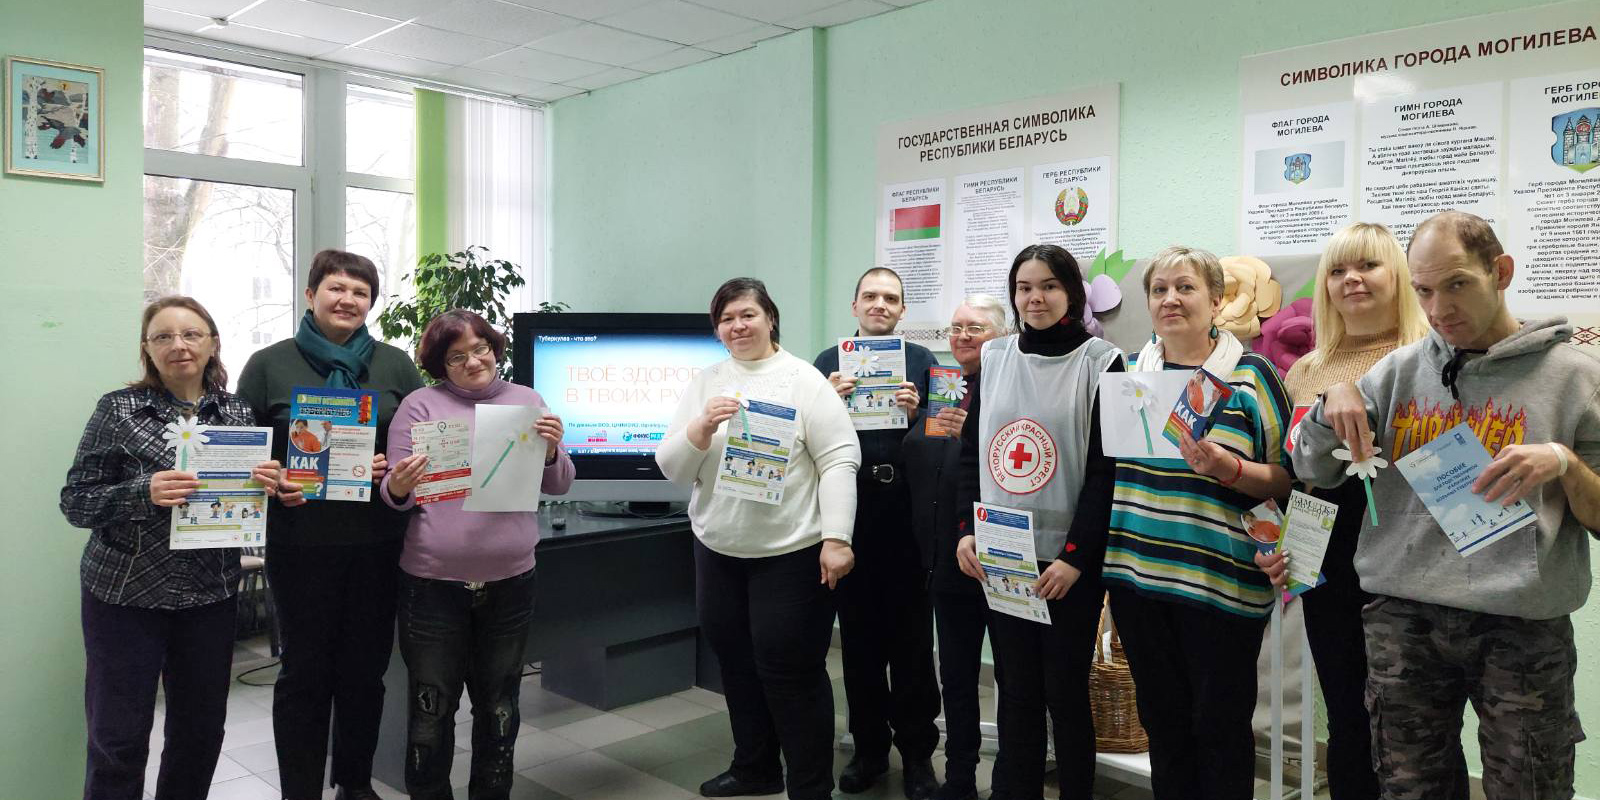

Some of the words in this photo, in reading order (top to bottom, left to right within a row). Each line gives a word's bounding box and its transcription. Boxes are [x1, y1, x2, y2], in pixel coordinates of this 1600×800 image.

[1281, 57, 1387, 87] СИМВОЛИКА
[1395, 44, 1471, 69] ГОРОДА
[1478, 26, 1597, 57] МОГИЛЕВА
[1545, 85, 1573, 94] ГЕРБ
[1394, 102, 1421, 113] ГИМН
[1423, 98, 1463, 110] ГОРОДА
[1271, 120, 1294, 128] ФЛАГ
[1297, 115, 1330, 126] ГОРОДА
[1401, 109, 1455, 121] МОГИЛЕВА
[899, 119, 1009, 149] ГОСУДАРСТВЕННАЯ
[1014, 105, 1095, 130] СИМВОЛИКА
[1277, 125, 1323, 137] МОГИЛЕВА
[920, 140, 995, 162] РЕСПУБЛИКИ
[999, 129, 1068, 151] БЕЛАРУСЬ
[1060, 166, 1101, 177] РЕСПУБЛИКИ
[980, 177, 1018, 187] РЕСПУБЛИКИ
[1055, 176, 1088, 184] БЕЛАРУСЬ
[976, 186, 1004, 194] БЕЛАРУСЬ
[567, 365, 616, 382] ТВОЁ
[566, 389, 579, 403] В
[588, 388, 651, 403] ТВОИХ
[1175, 401, 1197, 430] КАК
[291, 456, 319, 469] КАК
[1030, 461, 1052, 487] КРЕСТ
[1437, 462, 1467, 482] ПОСОБИЕ
